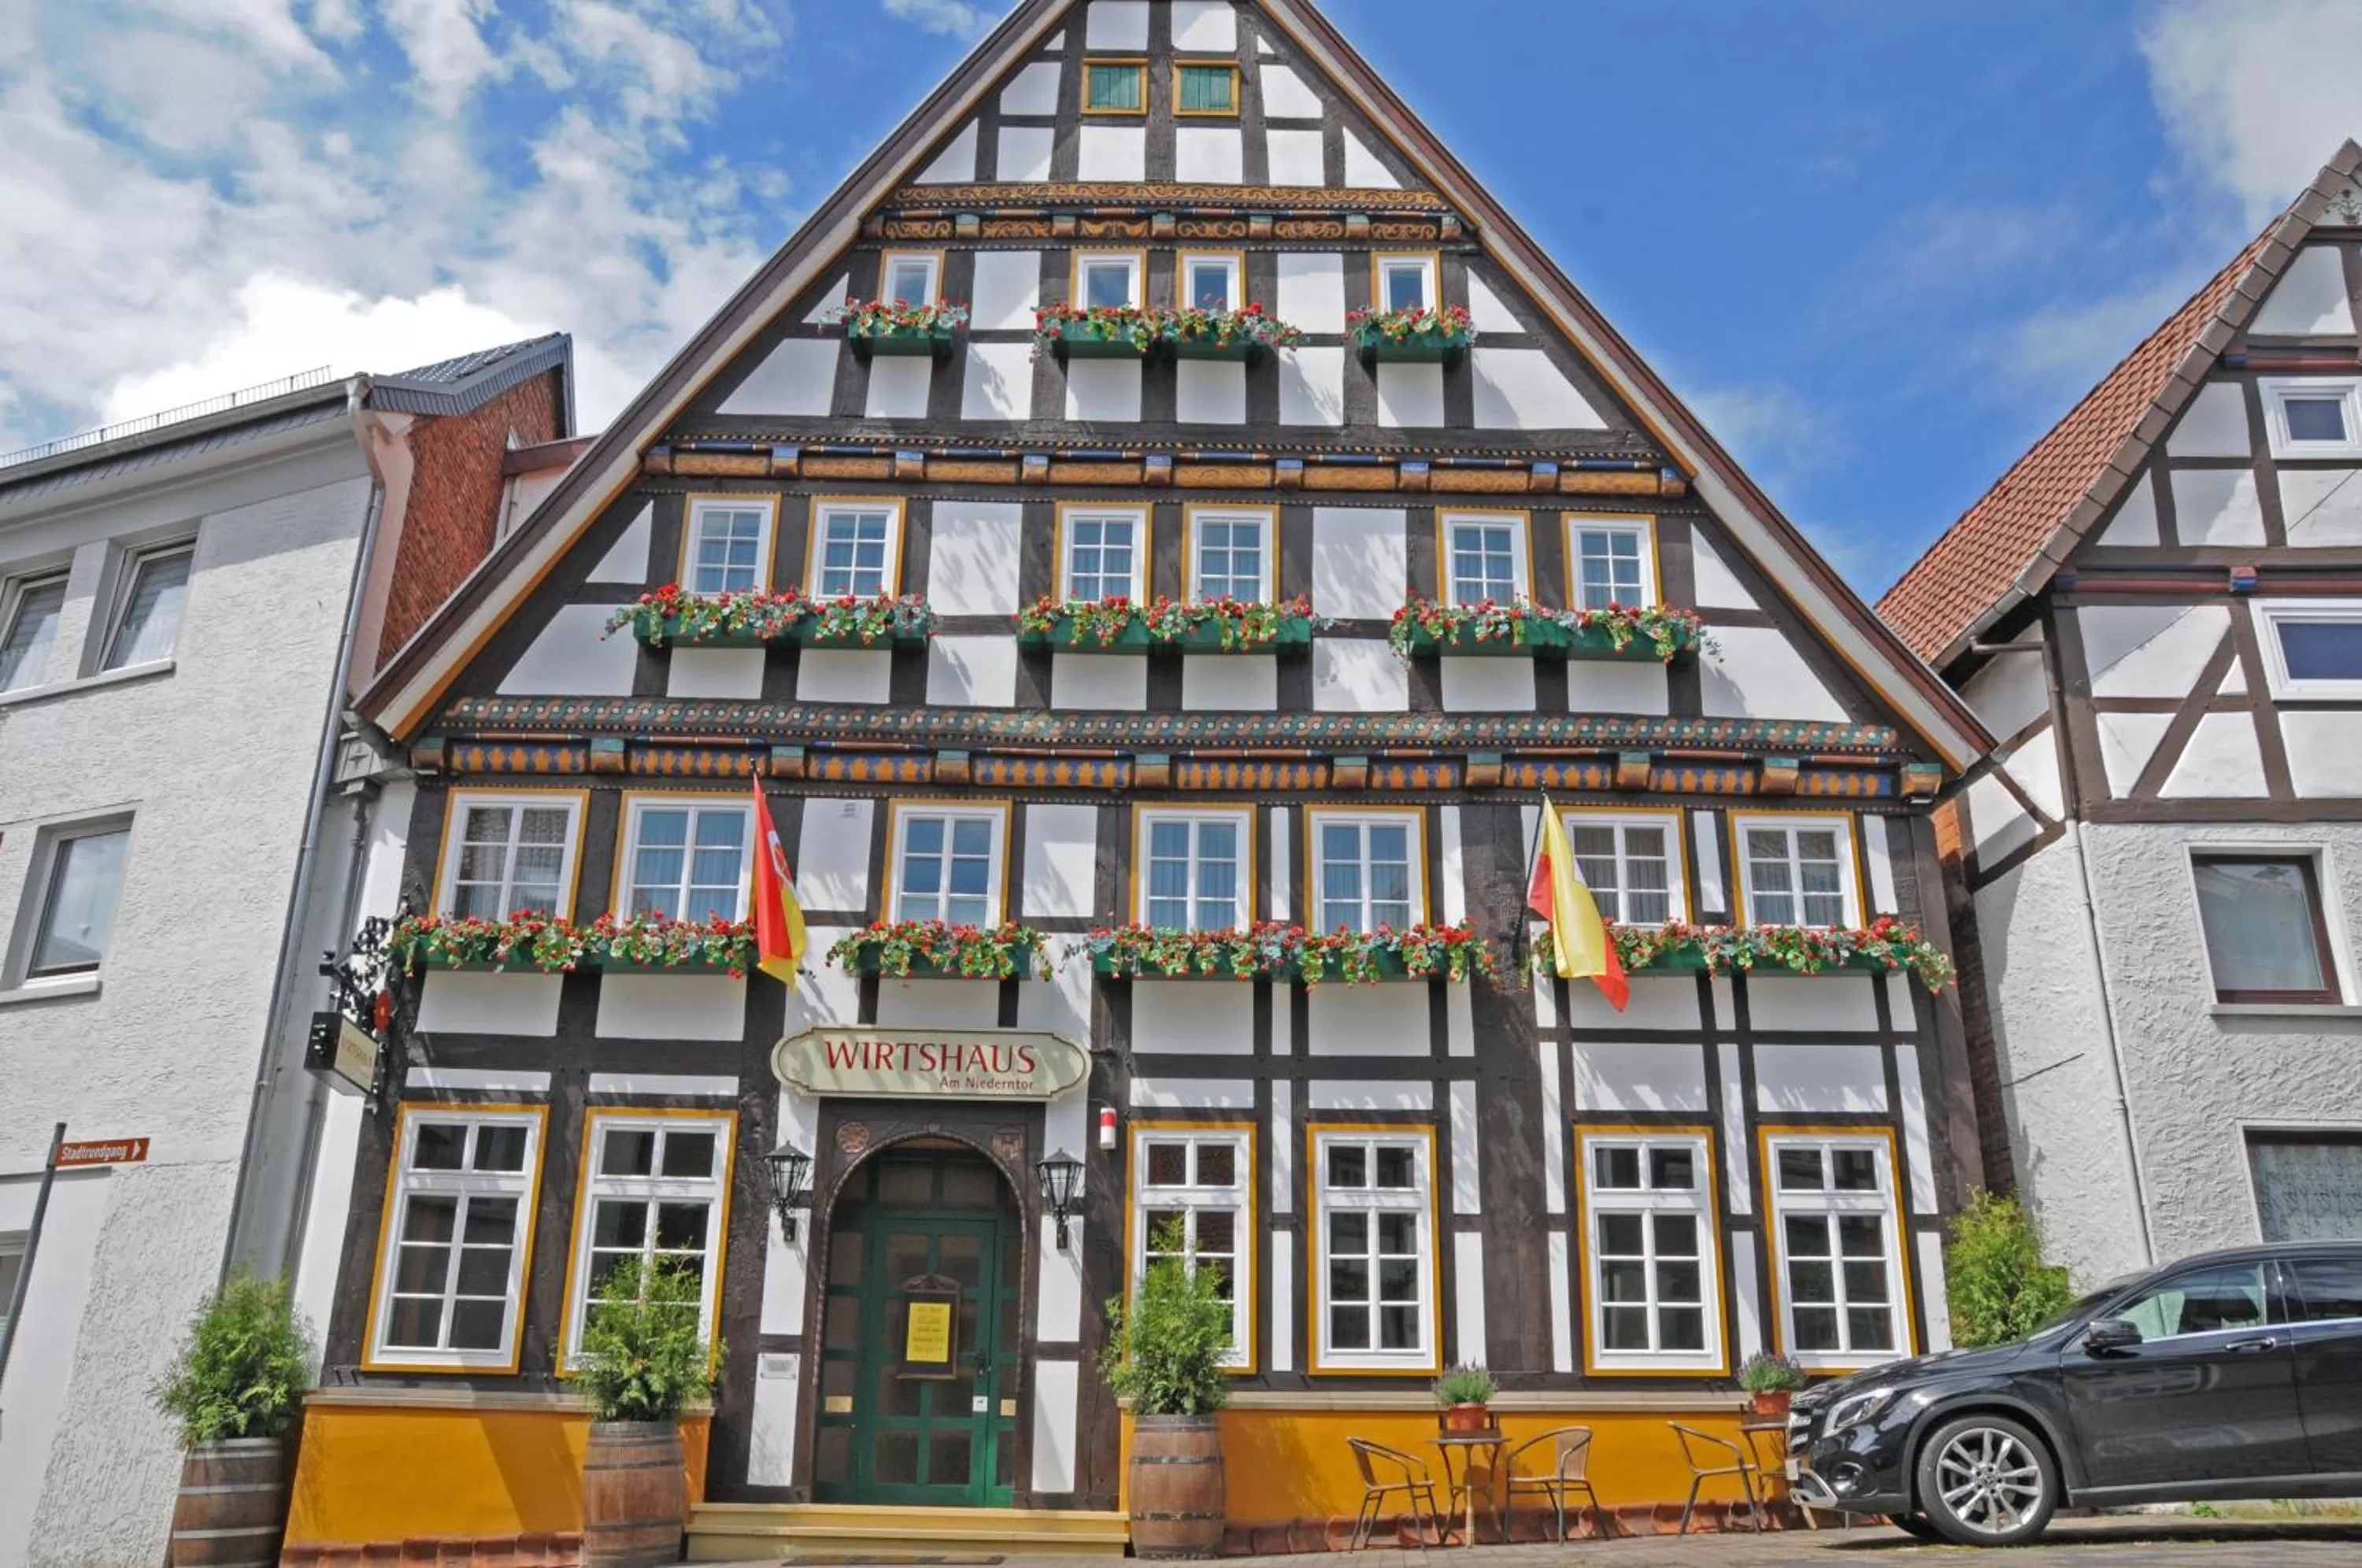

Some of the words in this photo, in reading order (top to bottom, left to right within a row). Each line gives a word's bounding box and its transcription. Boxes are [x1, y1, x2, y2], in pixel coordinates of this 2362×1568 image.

[824, 1041, 1036, 1074] WIRTSHAUS
[939, 1075, 960, 1089] Am
[965, 1077, 1034, 1090] Niederntor
